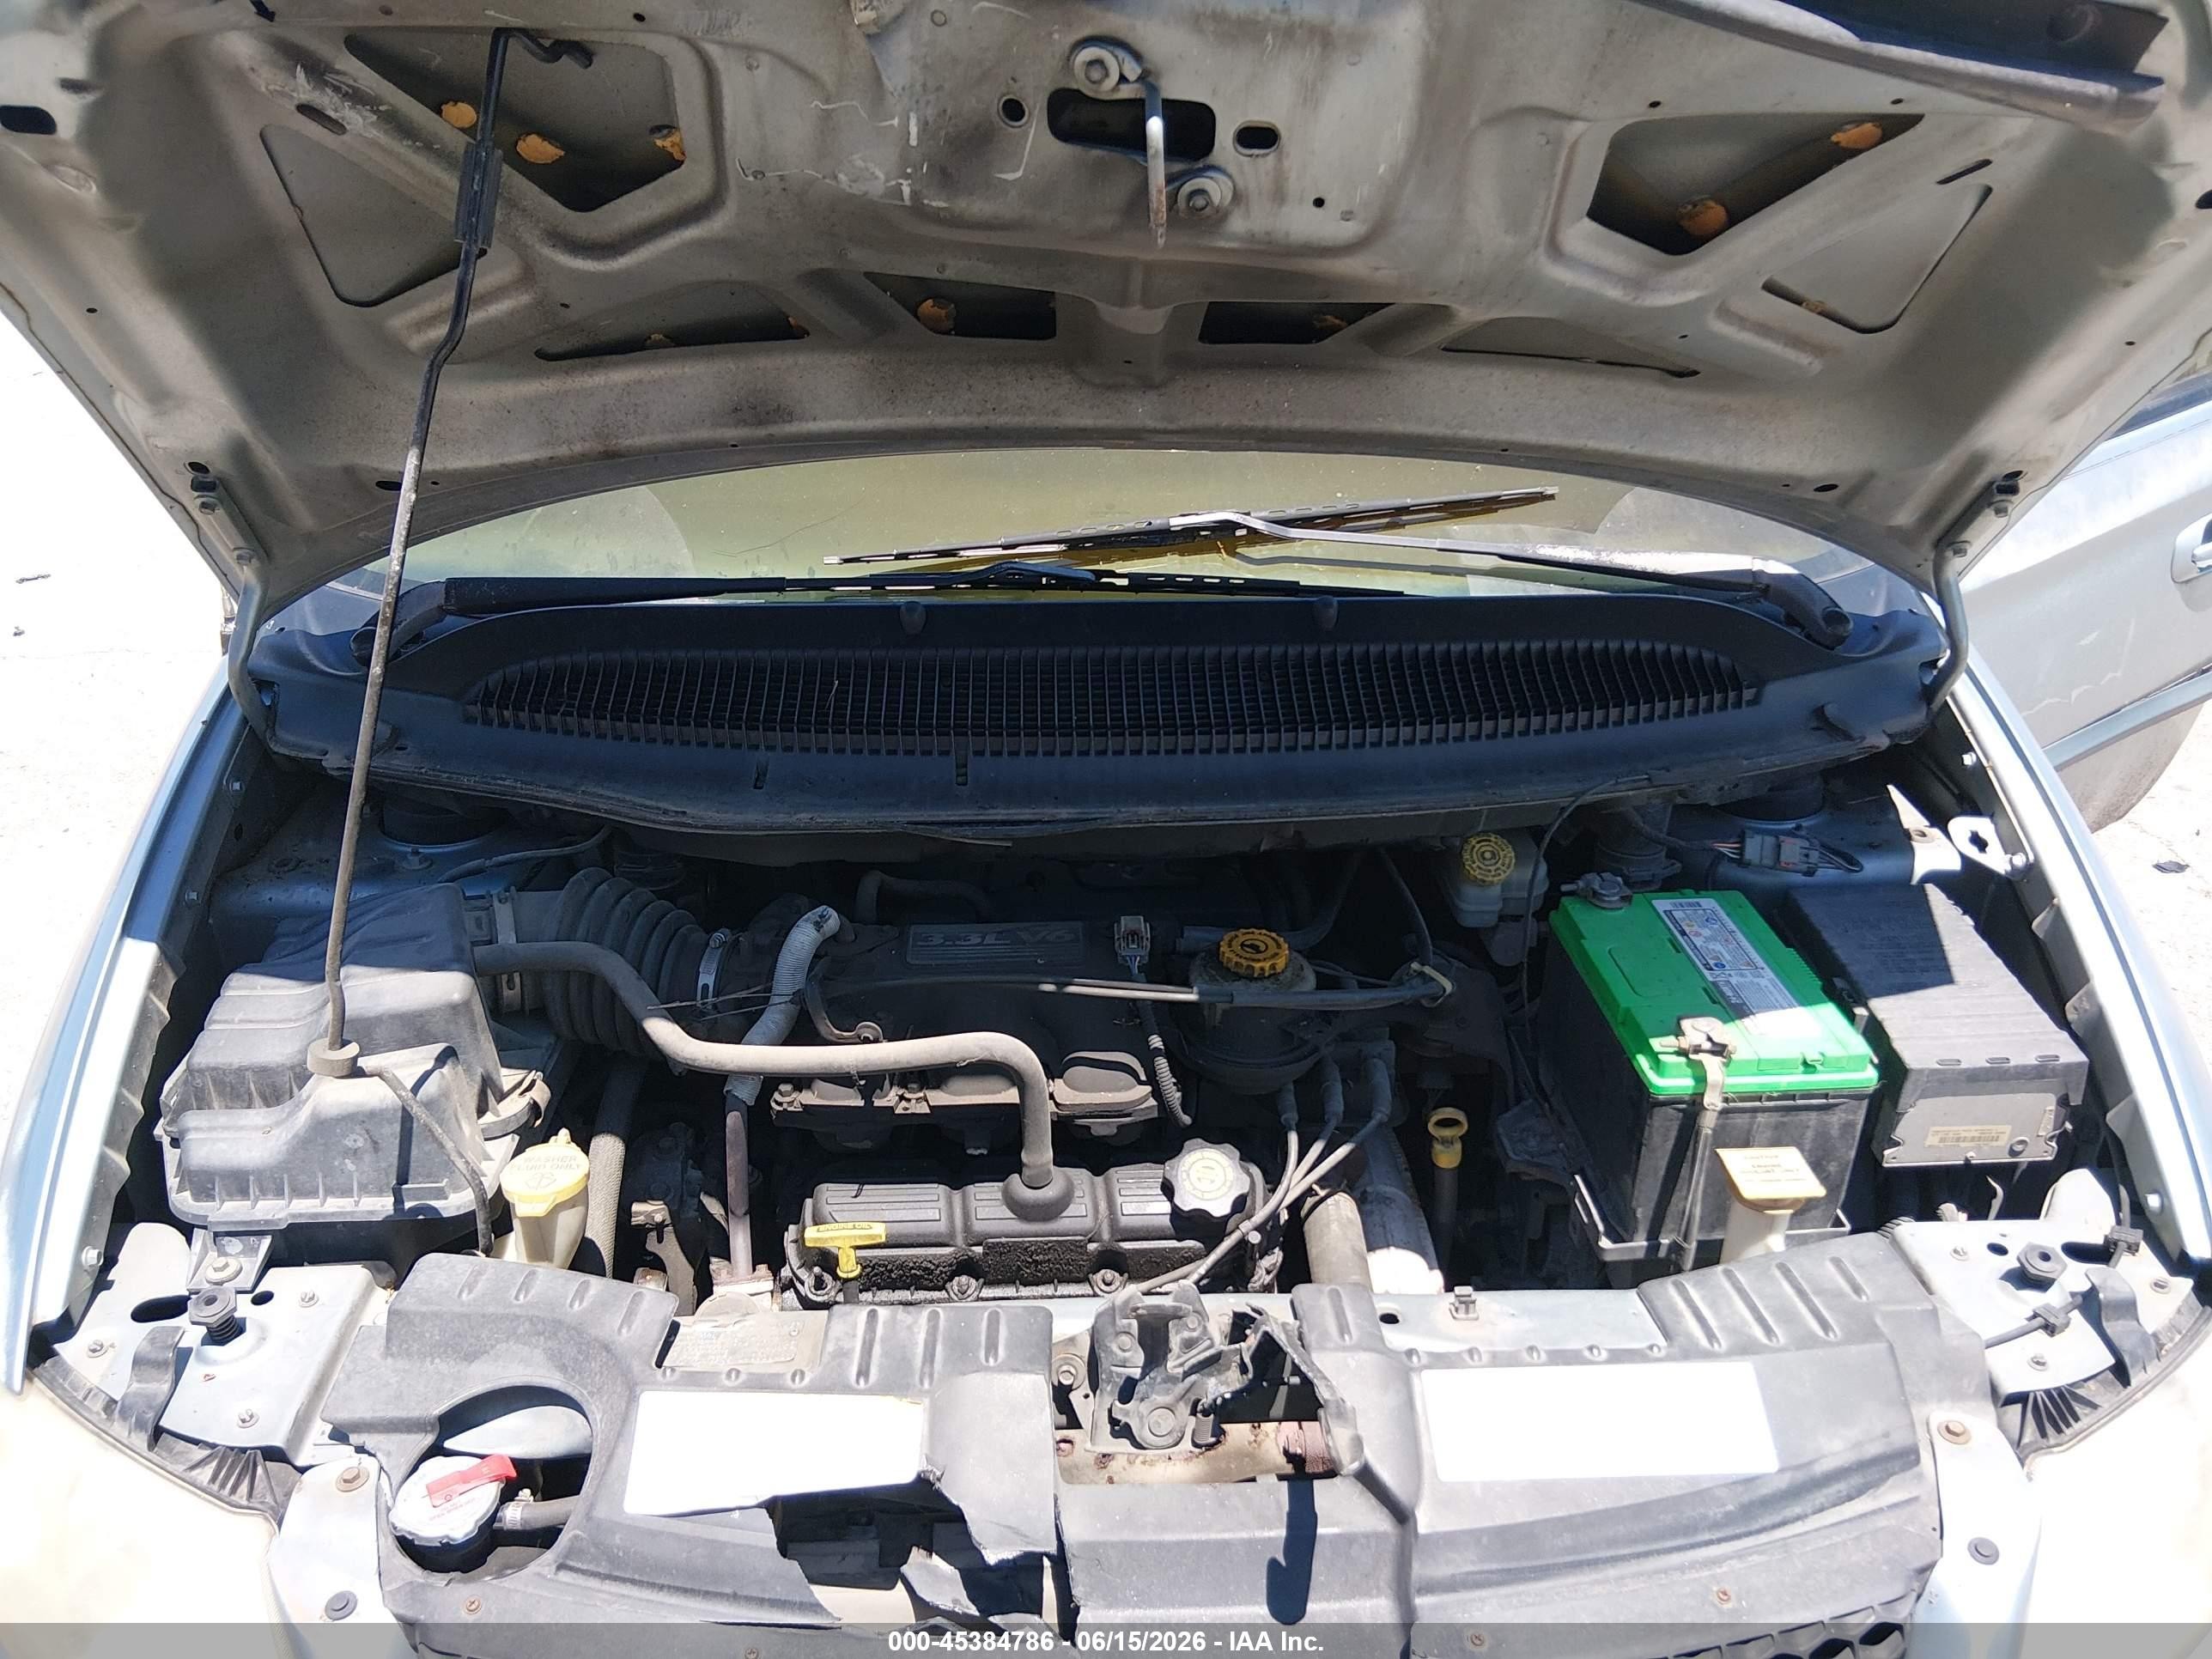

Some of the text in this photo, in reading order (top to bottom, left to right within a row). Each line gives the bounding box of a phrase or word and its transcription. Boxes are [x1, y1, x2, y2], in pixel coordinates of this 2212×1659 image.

[916, 928, 1076, 946] 3.3L V6
[817, 1223, 853, 1232] ENGINE
